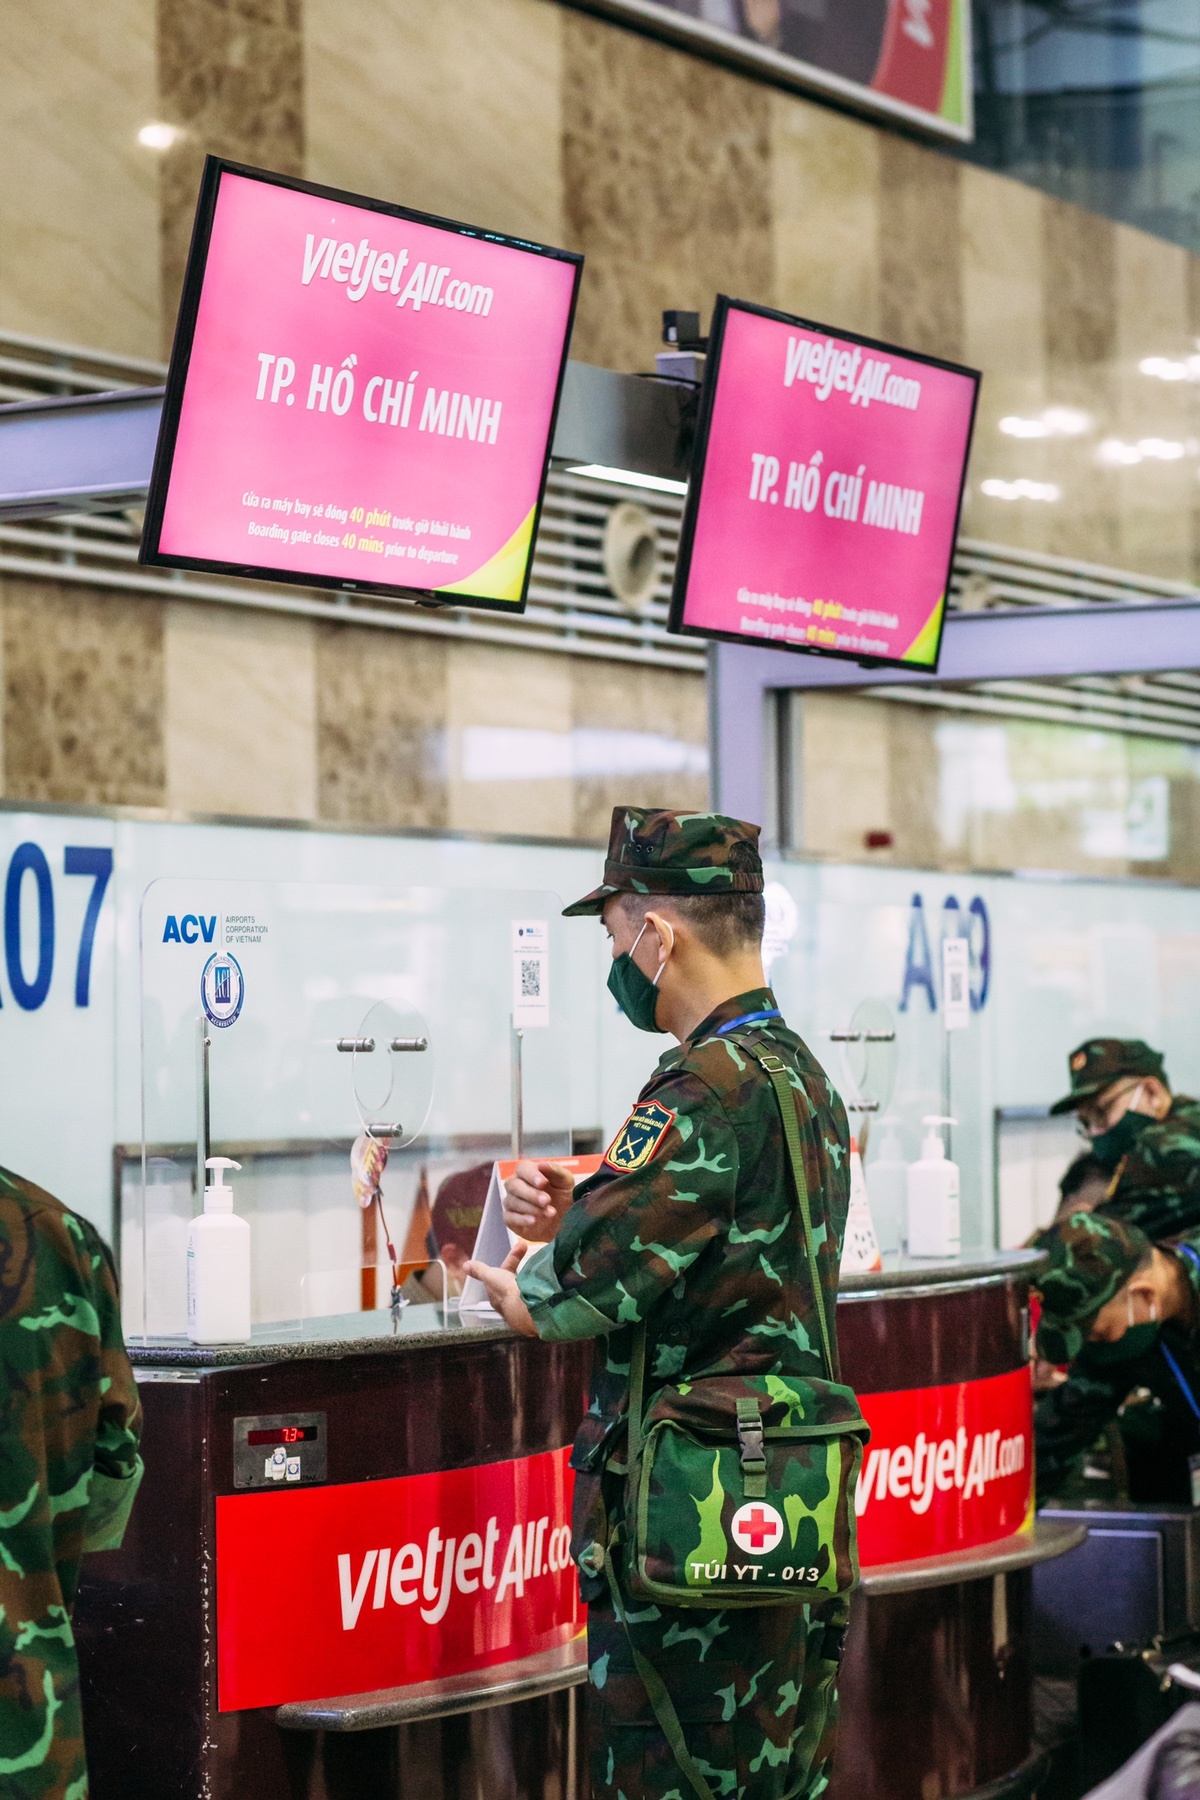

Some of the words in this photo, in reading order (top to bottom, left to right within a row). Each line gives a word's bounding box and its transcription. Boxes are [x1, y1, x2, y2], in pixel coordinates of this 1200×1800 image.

[256, 352, 296, 407] TP.
[306, 353, 358, 416] HỒ
[363, 370, 419, 428] CHÍ
[418, 387, 502, 445] MINH
[242, 490, 259, 507] Cửa
[260, 497, 271, 509] ra
[272, 497, 293, 516] máy
[294, 498, 312, 519] bay
[324, 503, 348, 525] đóng
[349, 506, 364, 523] 40
[364, 507, 392, 529] phút
[749, 452, 780, 505] TP.
[784, 450, 824, 513] HỒ
[823, 464, 866, 522] CHÍ
[862, 480, 925, 536] MINH
[248, 521, 289, 544] Boarding
[290, 529, 312, 545] gate
[313, 529, 340, 548] closes
[341, 533, 356, 550] 40
[357, 535, 384, 554] mins
[384, 541, 407, 558] prior
[407, 545, 417, 559] to
[417, 545, 459, 564] departure
[0, 841, 114, 1012] 07
[162, 914, 217, 944] ACV
[225, 915, 256, 924] AIRPORTS
[225, 925, 269, 934] CORPORATION
[225, 935, 234, 943] OF
[235, 935, 262, 943] VIETNAM
[690, 1559, 727, 1579] TÚI
[733, 1564, 763, 1580] YT
[781, 1566, 820, 1582] 013
